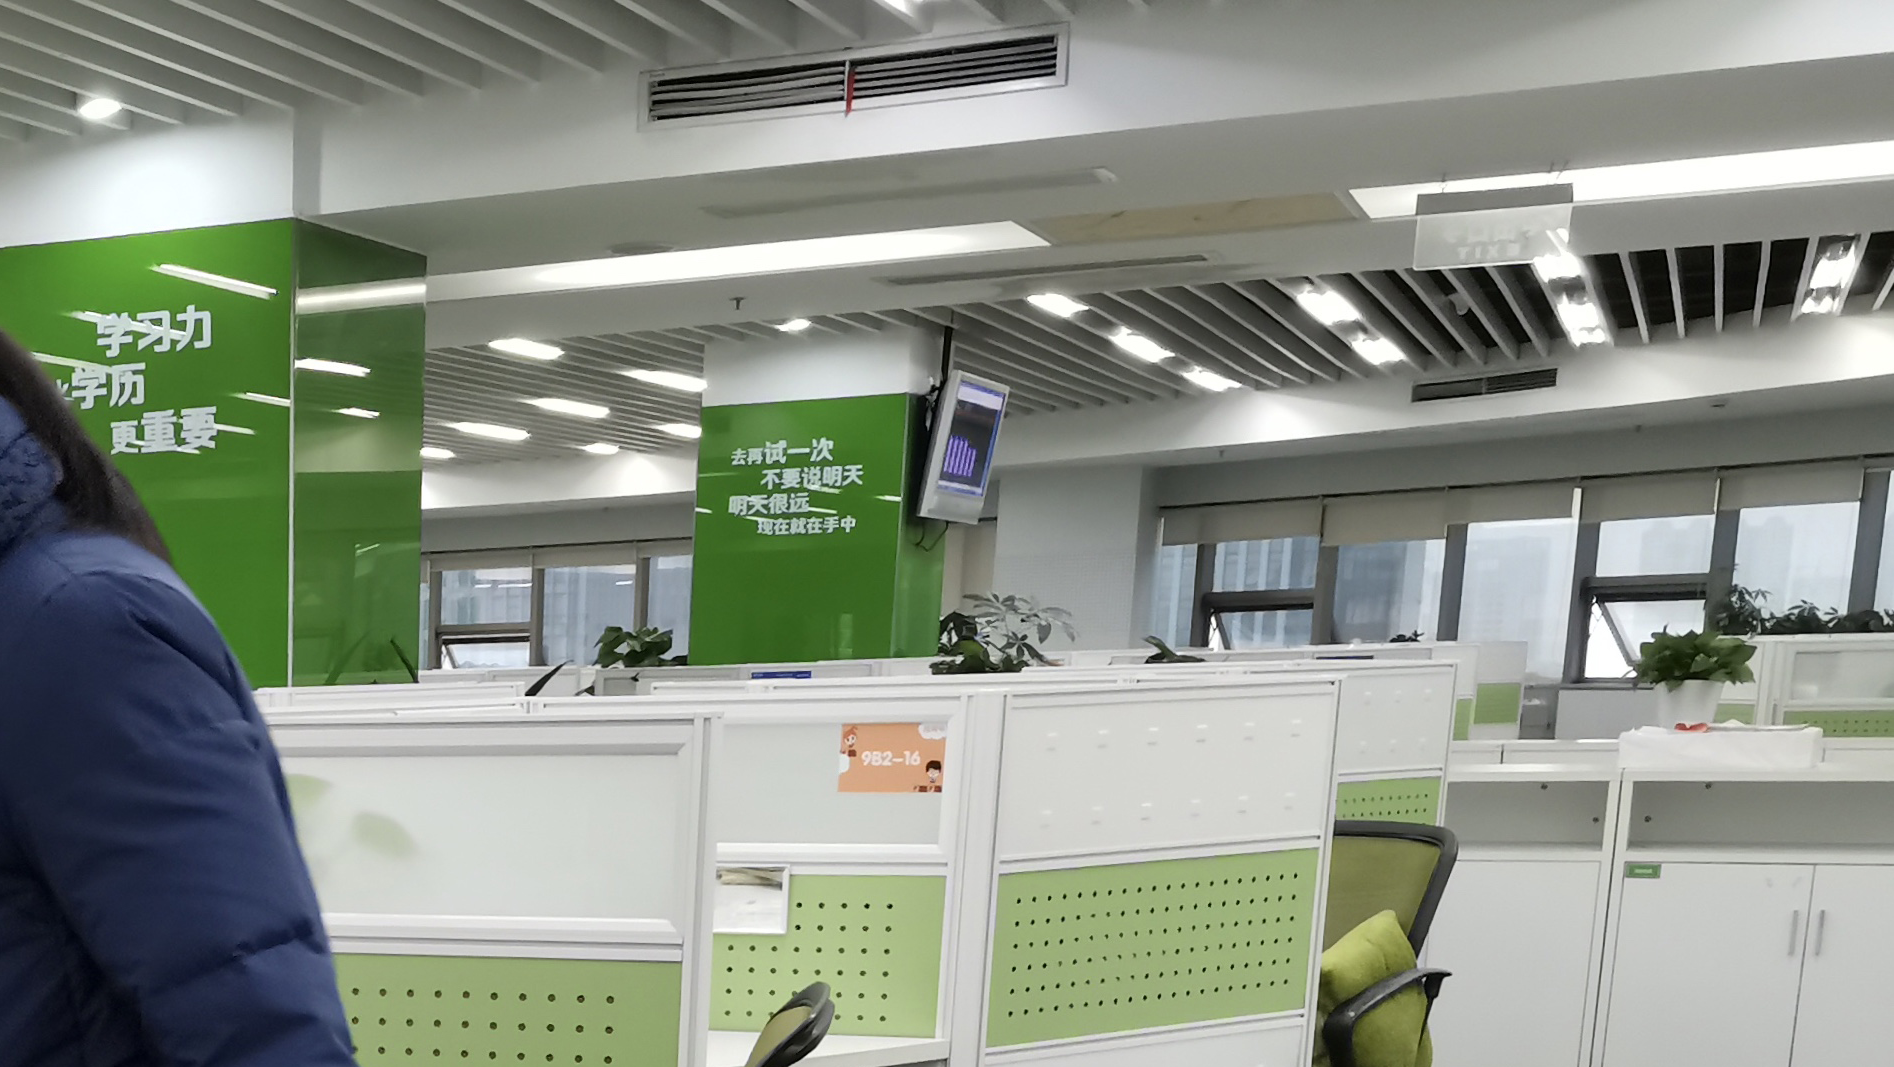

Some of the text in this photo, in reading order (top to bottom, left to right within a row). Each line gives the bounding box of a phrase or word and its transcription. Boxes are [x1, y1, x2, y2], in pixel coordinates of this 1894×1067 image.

[96, 304, 212, 358] 学习力
[110, 406, 218, 455] 更重要
[730, 436, 834, 466] 去再试一次
[760, 464, 864, 491] 不要说明天
[728, 491, 810, 517] 明天很远
[756, 515, 857, 536] 现在就在手中
